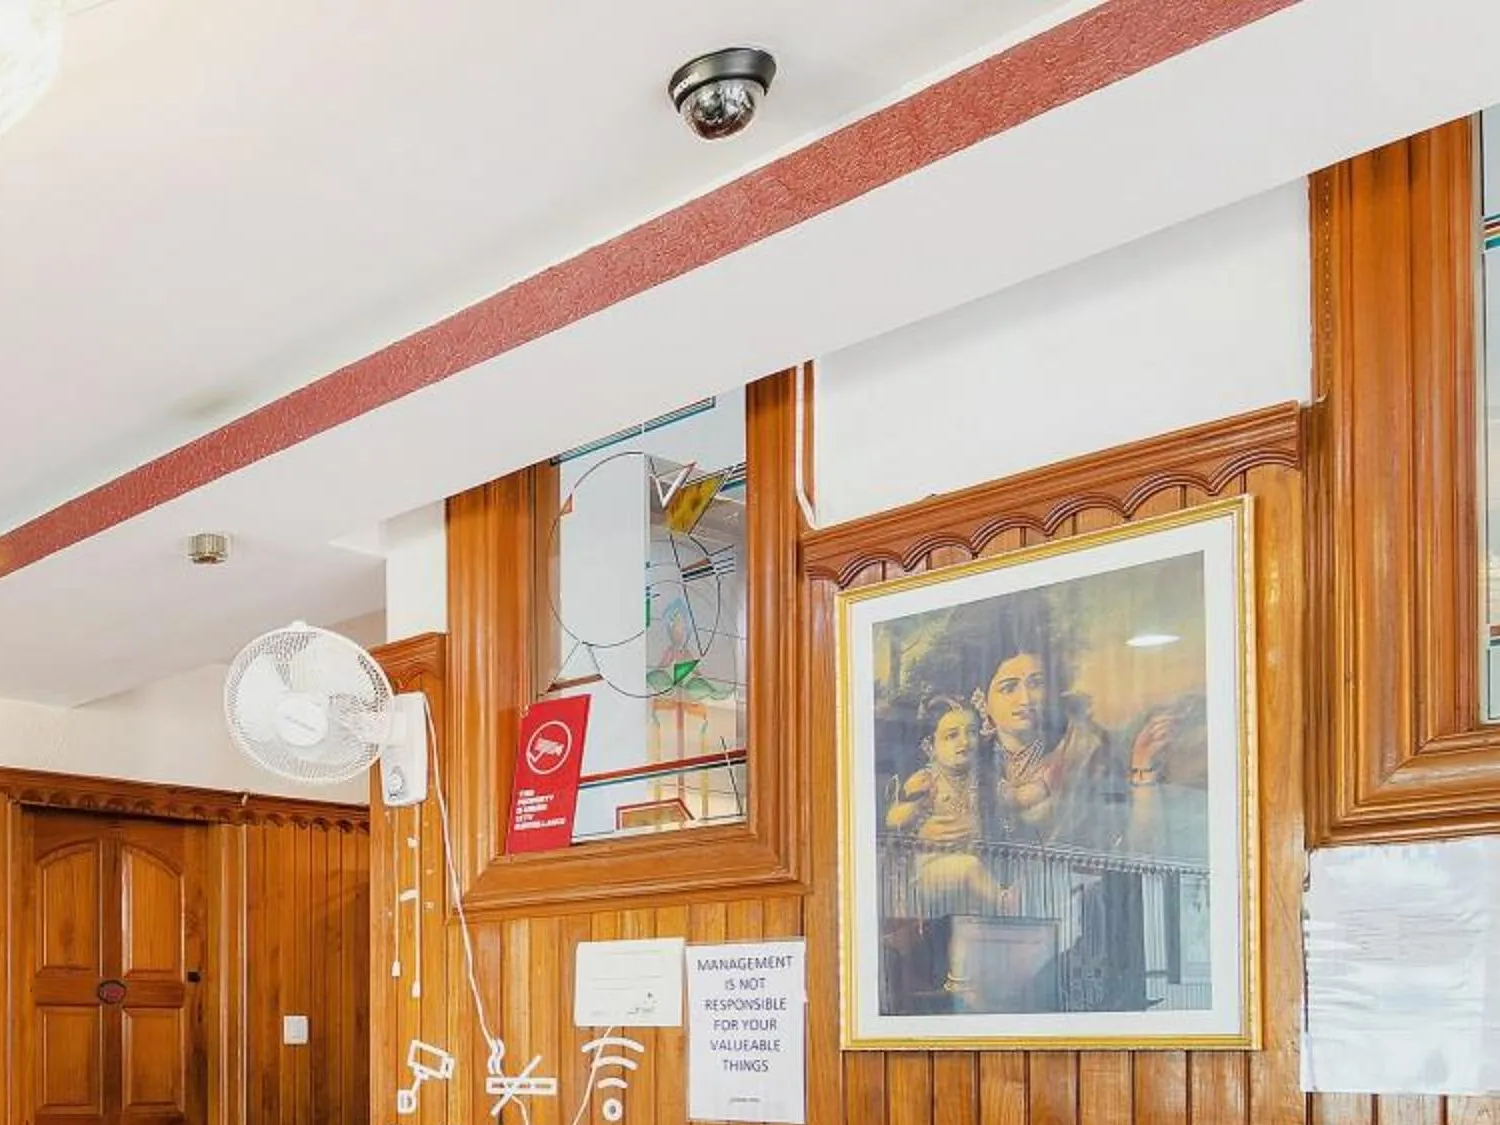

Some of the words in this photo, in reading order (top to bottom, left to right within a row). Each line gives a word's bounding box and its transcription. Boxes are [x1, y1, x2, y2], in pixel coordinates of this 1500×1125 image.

[697, 955, 794, 971] MANAGEMENT
[725, 979, 735, 991] IS
[739, 977, 765, 990] NOT
[704, 997, 787, 1011] RESPONSIBLE
[714, 1019, 739, 1031] FOR
[741, 1018, 777, 1031] YOUR
[710, 1039, 781, 1052] VALUEABLE
[723, 1059, 769, 1073] THINGS
